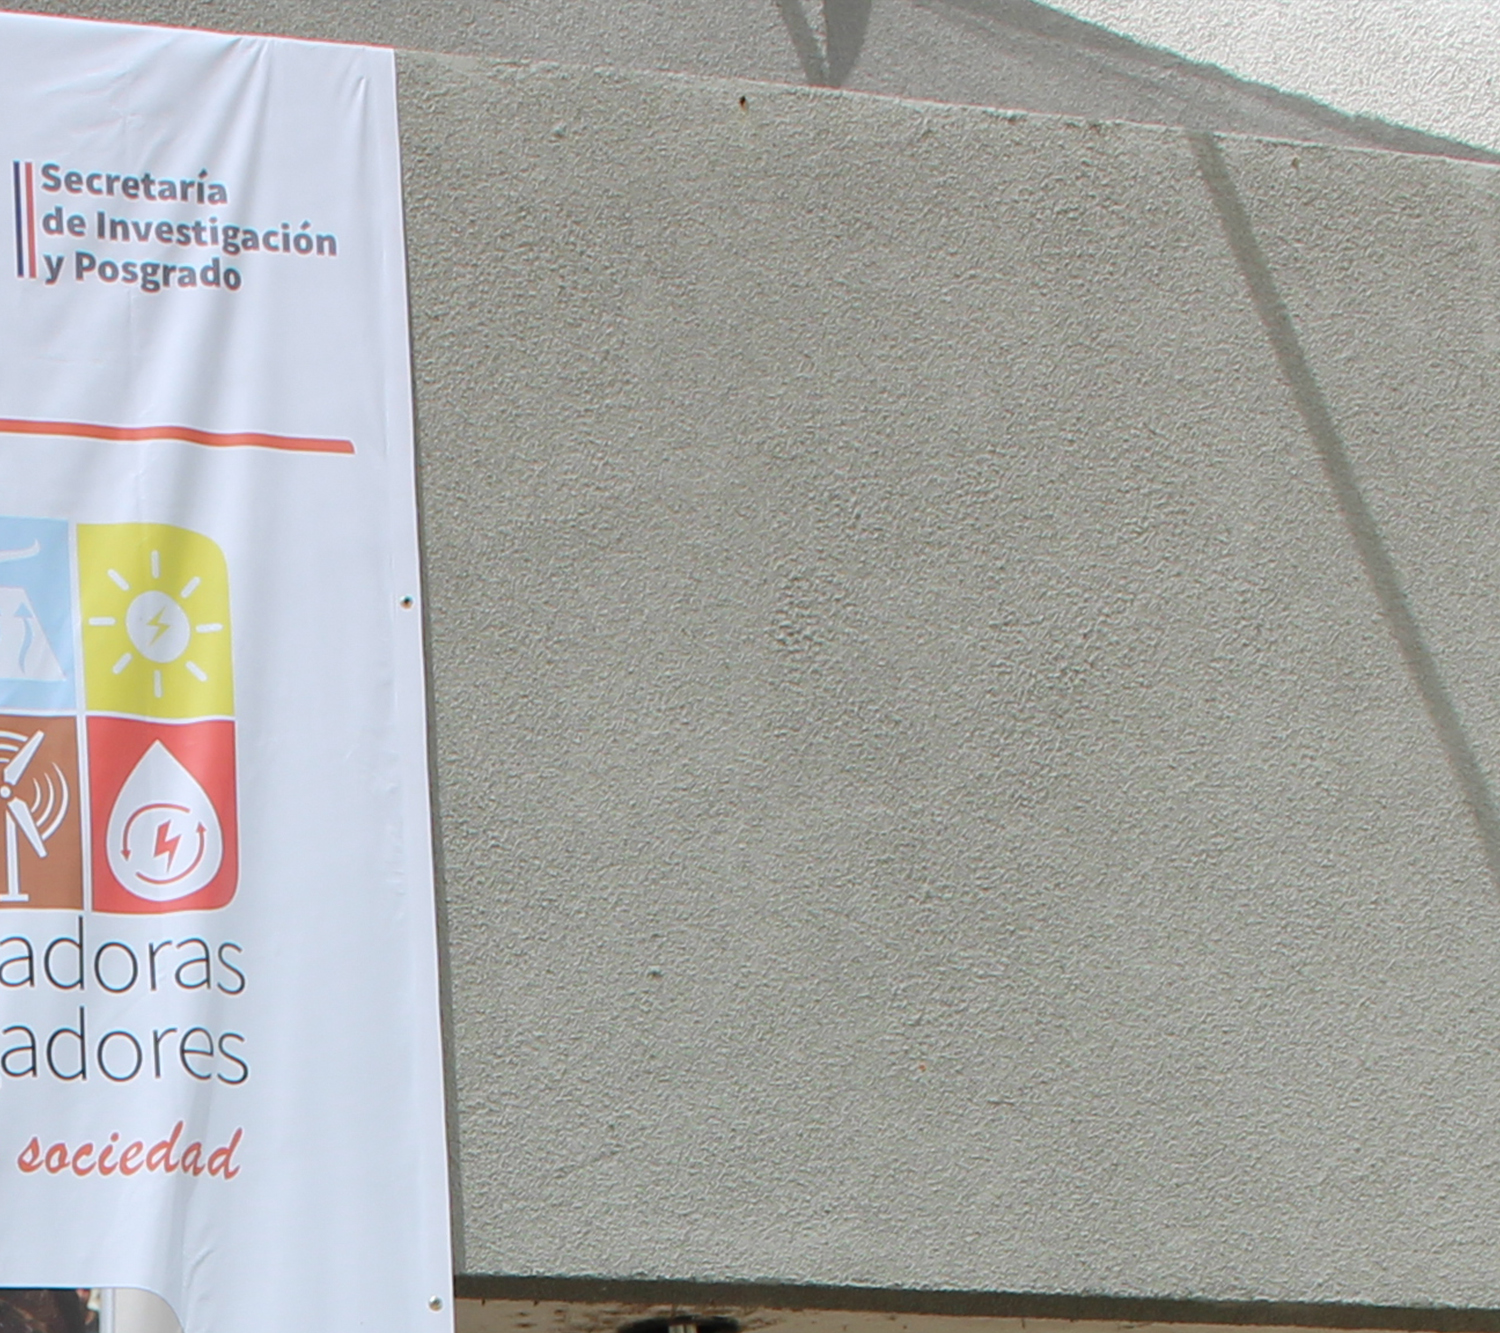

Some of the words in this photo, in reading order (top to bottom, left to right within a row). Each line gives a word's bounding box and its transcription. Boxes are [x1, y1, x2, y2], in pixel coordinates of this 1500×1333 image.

[40, 162, 229, 207] Secretaría
[41, 207, 87, 237] de
[95, 208, 339, 260] Investigación
[44, 257, 64, 287] y
[73, 249, 242, 294] Posgrado
[17, 1118, 244, 1181] sociedad
